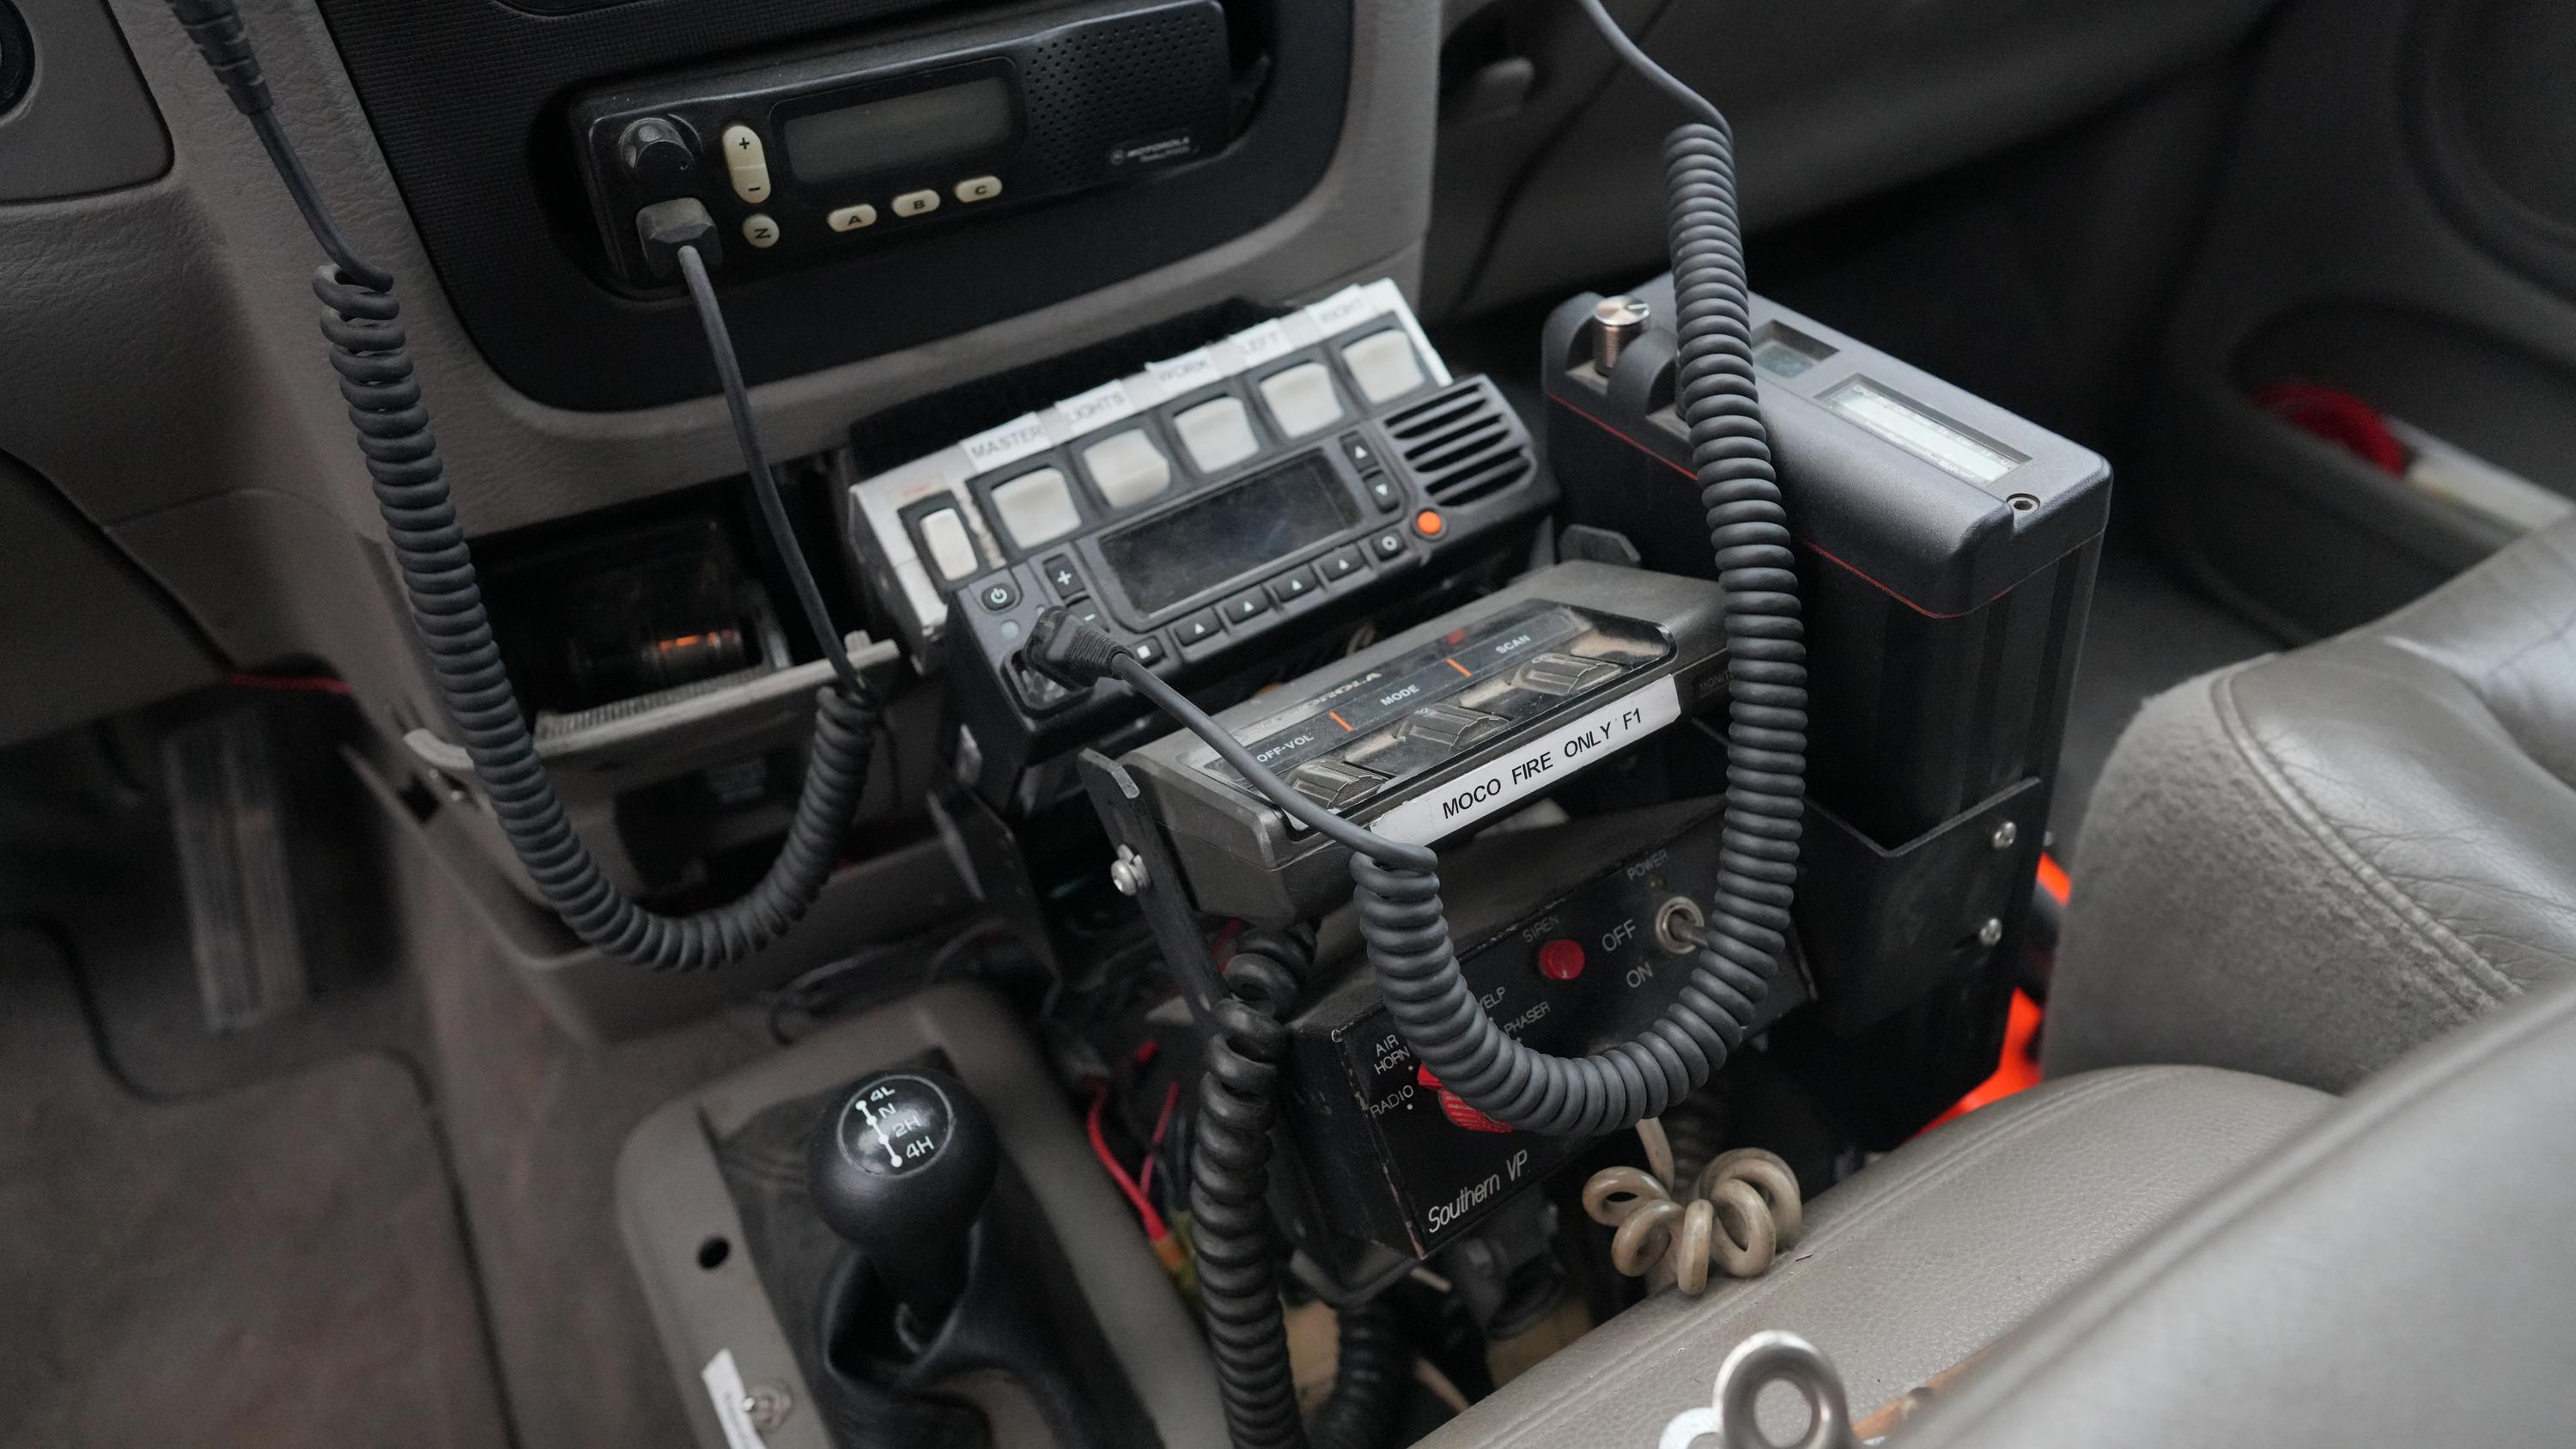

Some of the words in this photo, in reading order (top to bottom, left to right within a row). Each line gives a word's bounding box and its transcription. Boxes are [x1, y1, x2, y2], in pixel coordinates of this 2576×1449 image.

[975, 185, 988, 196] C
[914, 199, 926, 210] B
[848, 215, 863, 226] A
[1066, 393, 1125, 423] LIGHTS
[971, 425, 1043, 459] MASTER
[1496, 634, 1531, 654] SCAN
[1380, 685, 1420, 706] MODE
[1442, 778, 1502, 819] MOCO
[1511, 752, 1553, 785] FIRE
[1564, 721, 1612, 758] ONLY
[1622, 708, 1642, 730] F1
[1626, 849, 1668, 882] POWER
[1522, 914, 1560, 943] SIREN
[1602, 919, 1637, 952] OFF
[1626, 962, 1654, 988] ON
[1504, 1001, 1551, 1037] PHASER
[1376, 1033, 1400, 1057] AIR
[1374, 1045, 1411, 1075] HORN
[870, 1087, 896, 1102] 4L
[1370, 1085, 1415, 1119] RADIO
[878, 1103, 896, 1118] N
[893, 1115, 921, 1138] 2H
[906, 1135, 934, 1159] 4H
[1428, 1174, 1501, 1233] Southern
[1506, 1149, 1528, 1182] VP
